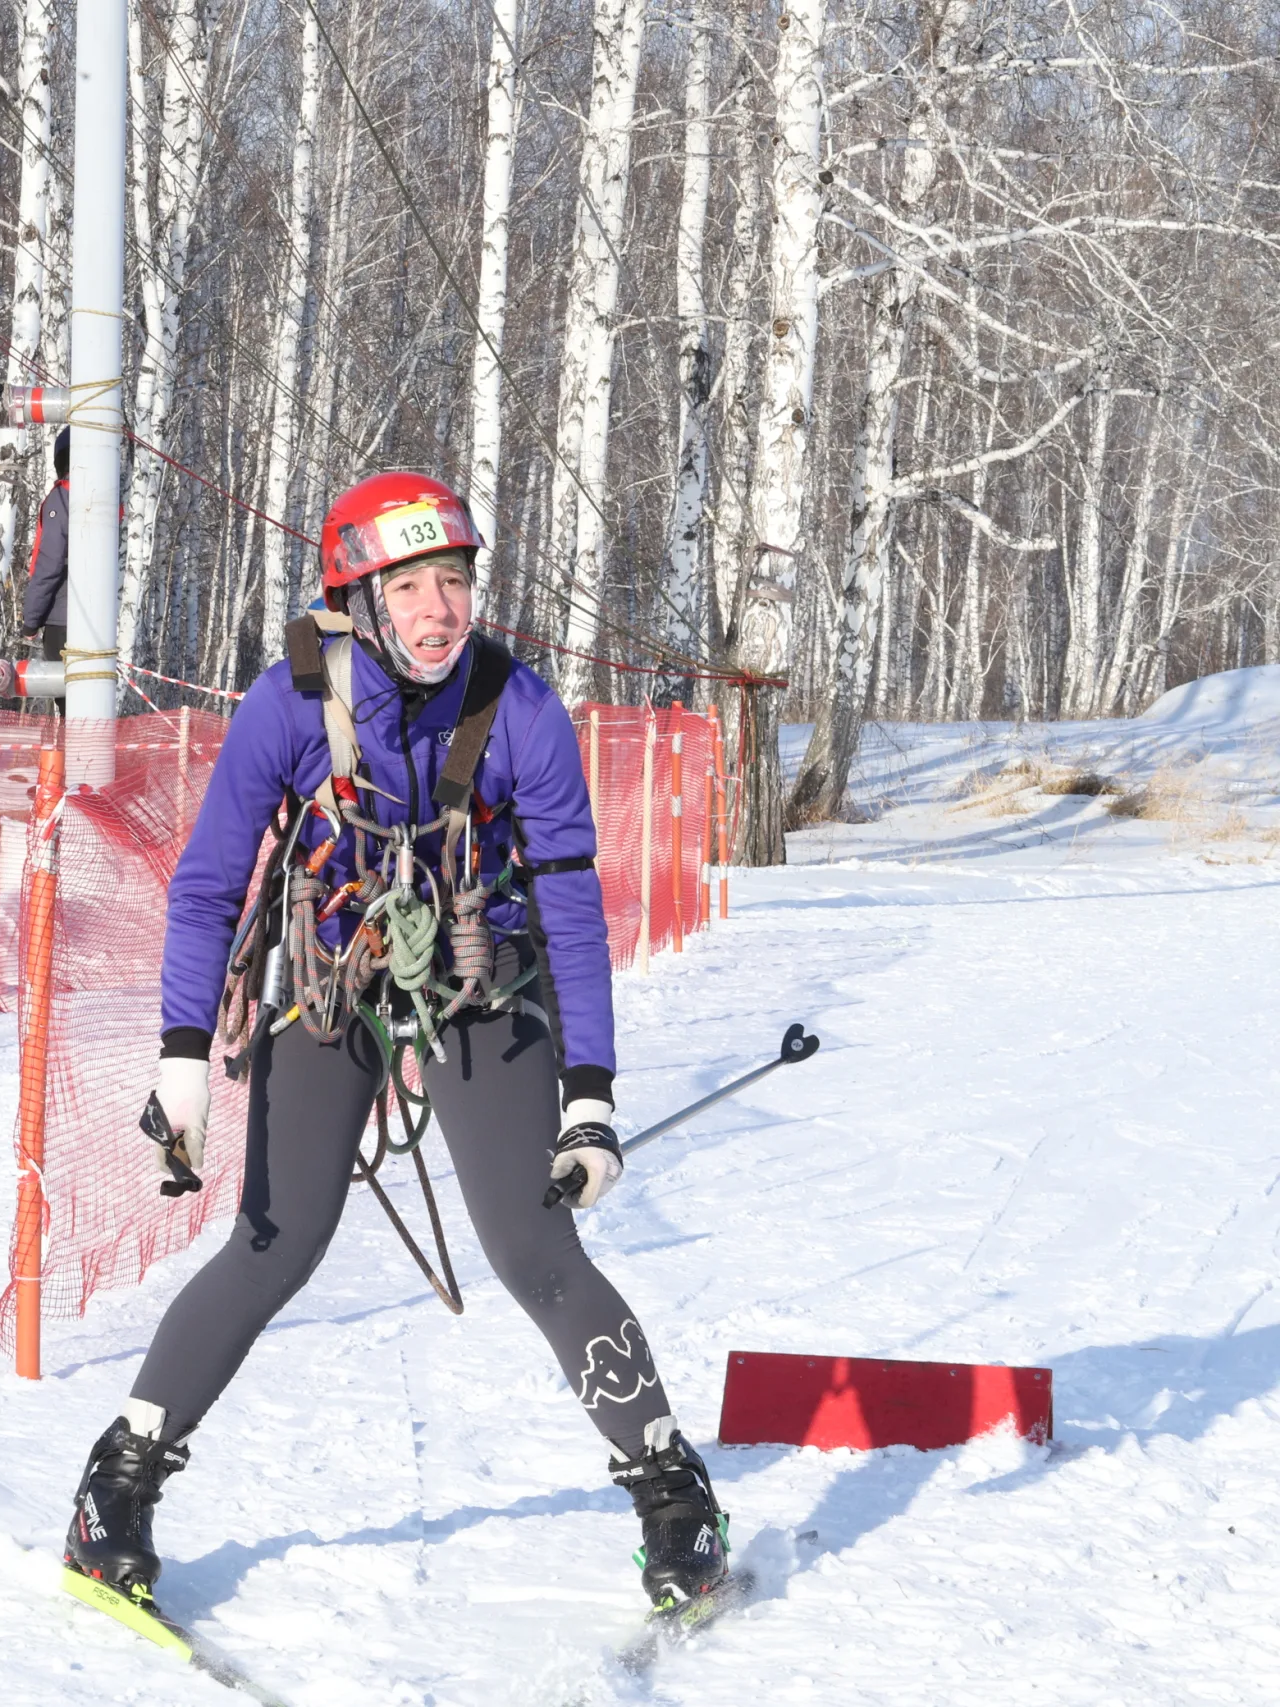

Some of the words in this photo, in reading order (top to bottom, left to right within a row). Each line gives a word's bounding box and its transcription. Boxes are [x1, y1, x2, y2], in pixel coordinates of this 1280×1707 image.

[400, 521, 437, 547] 133
[85, 1491, 108, 1542] SPINE
[93, 1587, 120, 1607] FISCHER
